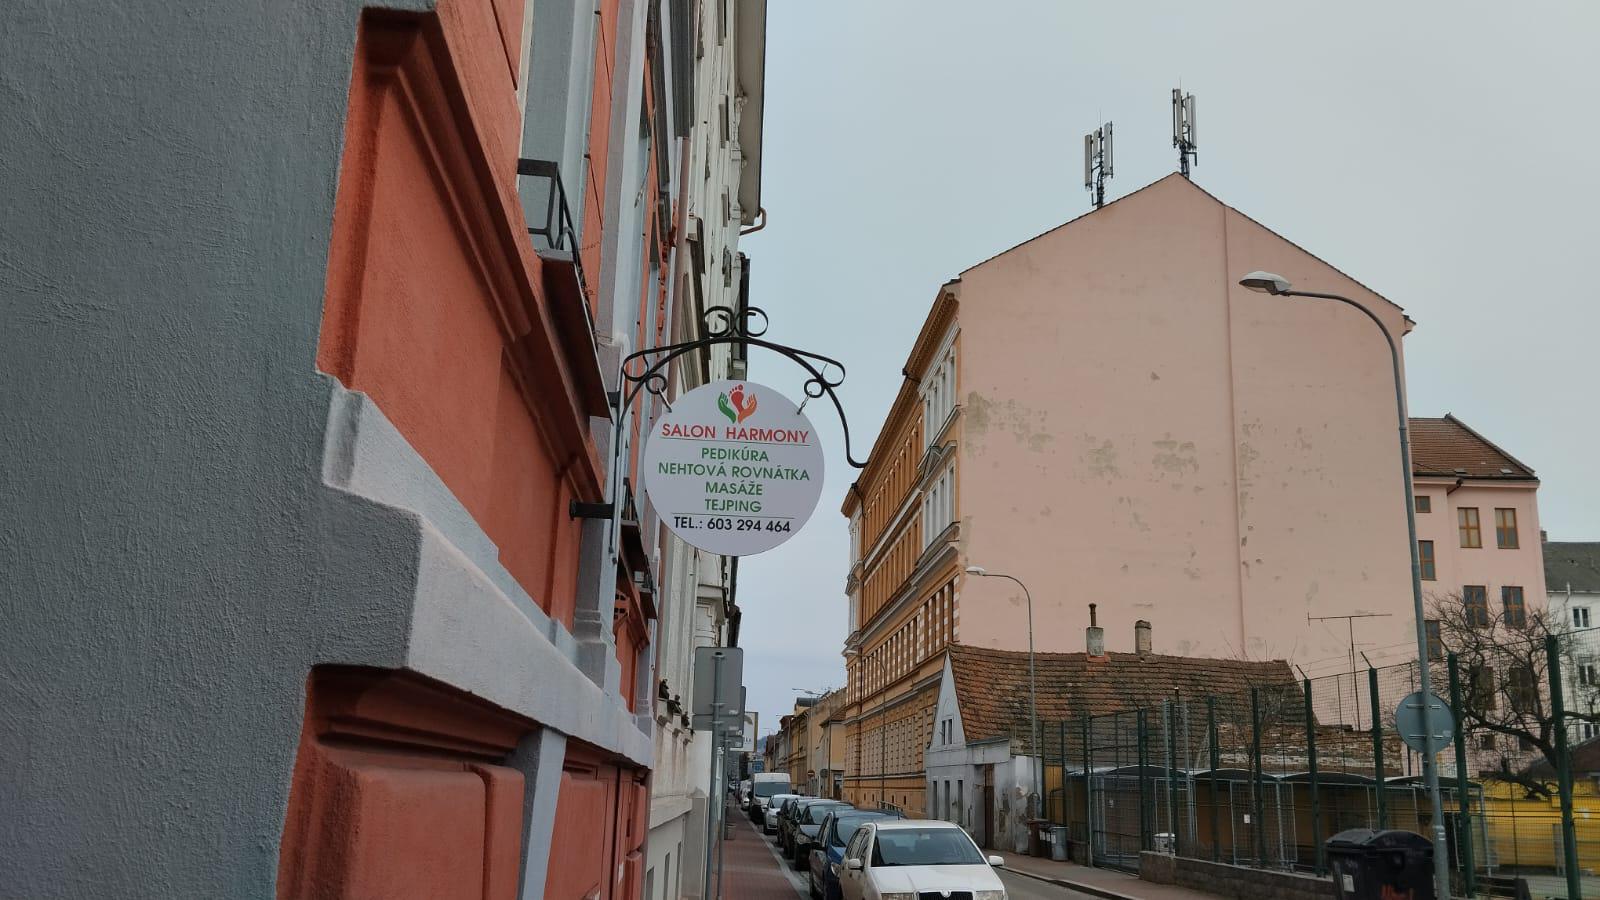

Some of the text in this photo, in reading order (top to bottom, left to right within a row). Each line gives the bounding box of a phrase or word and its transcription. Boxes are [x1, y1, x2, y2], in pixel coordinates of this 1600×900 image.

[662, 424, 809, 443] SALON HARMONY
[701, 446, 769, 461] PEDIKÚRA
[658, 462, 810, 481] NEHTOVÁ ROVNÁTKA
[705, 481, 763, 495] MASÁŽE
[705, 499, 762, 513] TEJPING
[674, 517, 791, 532] TEL.: 603 294 464
